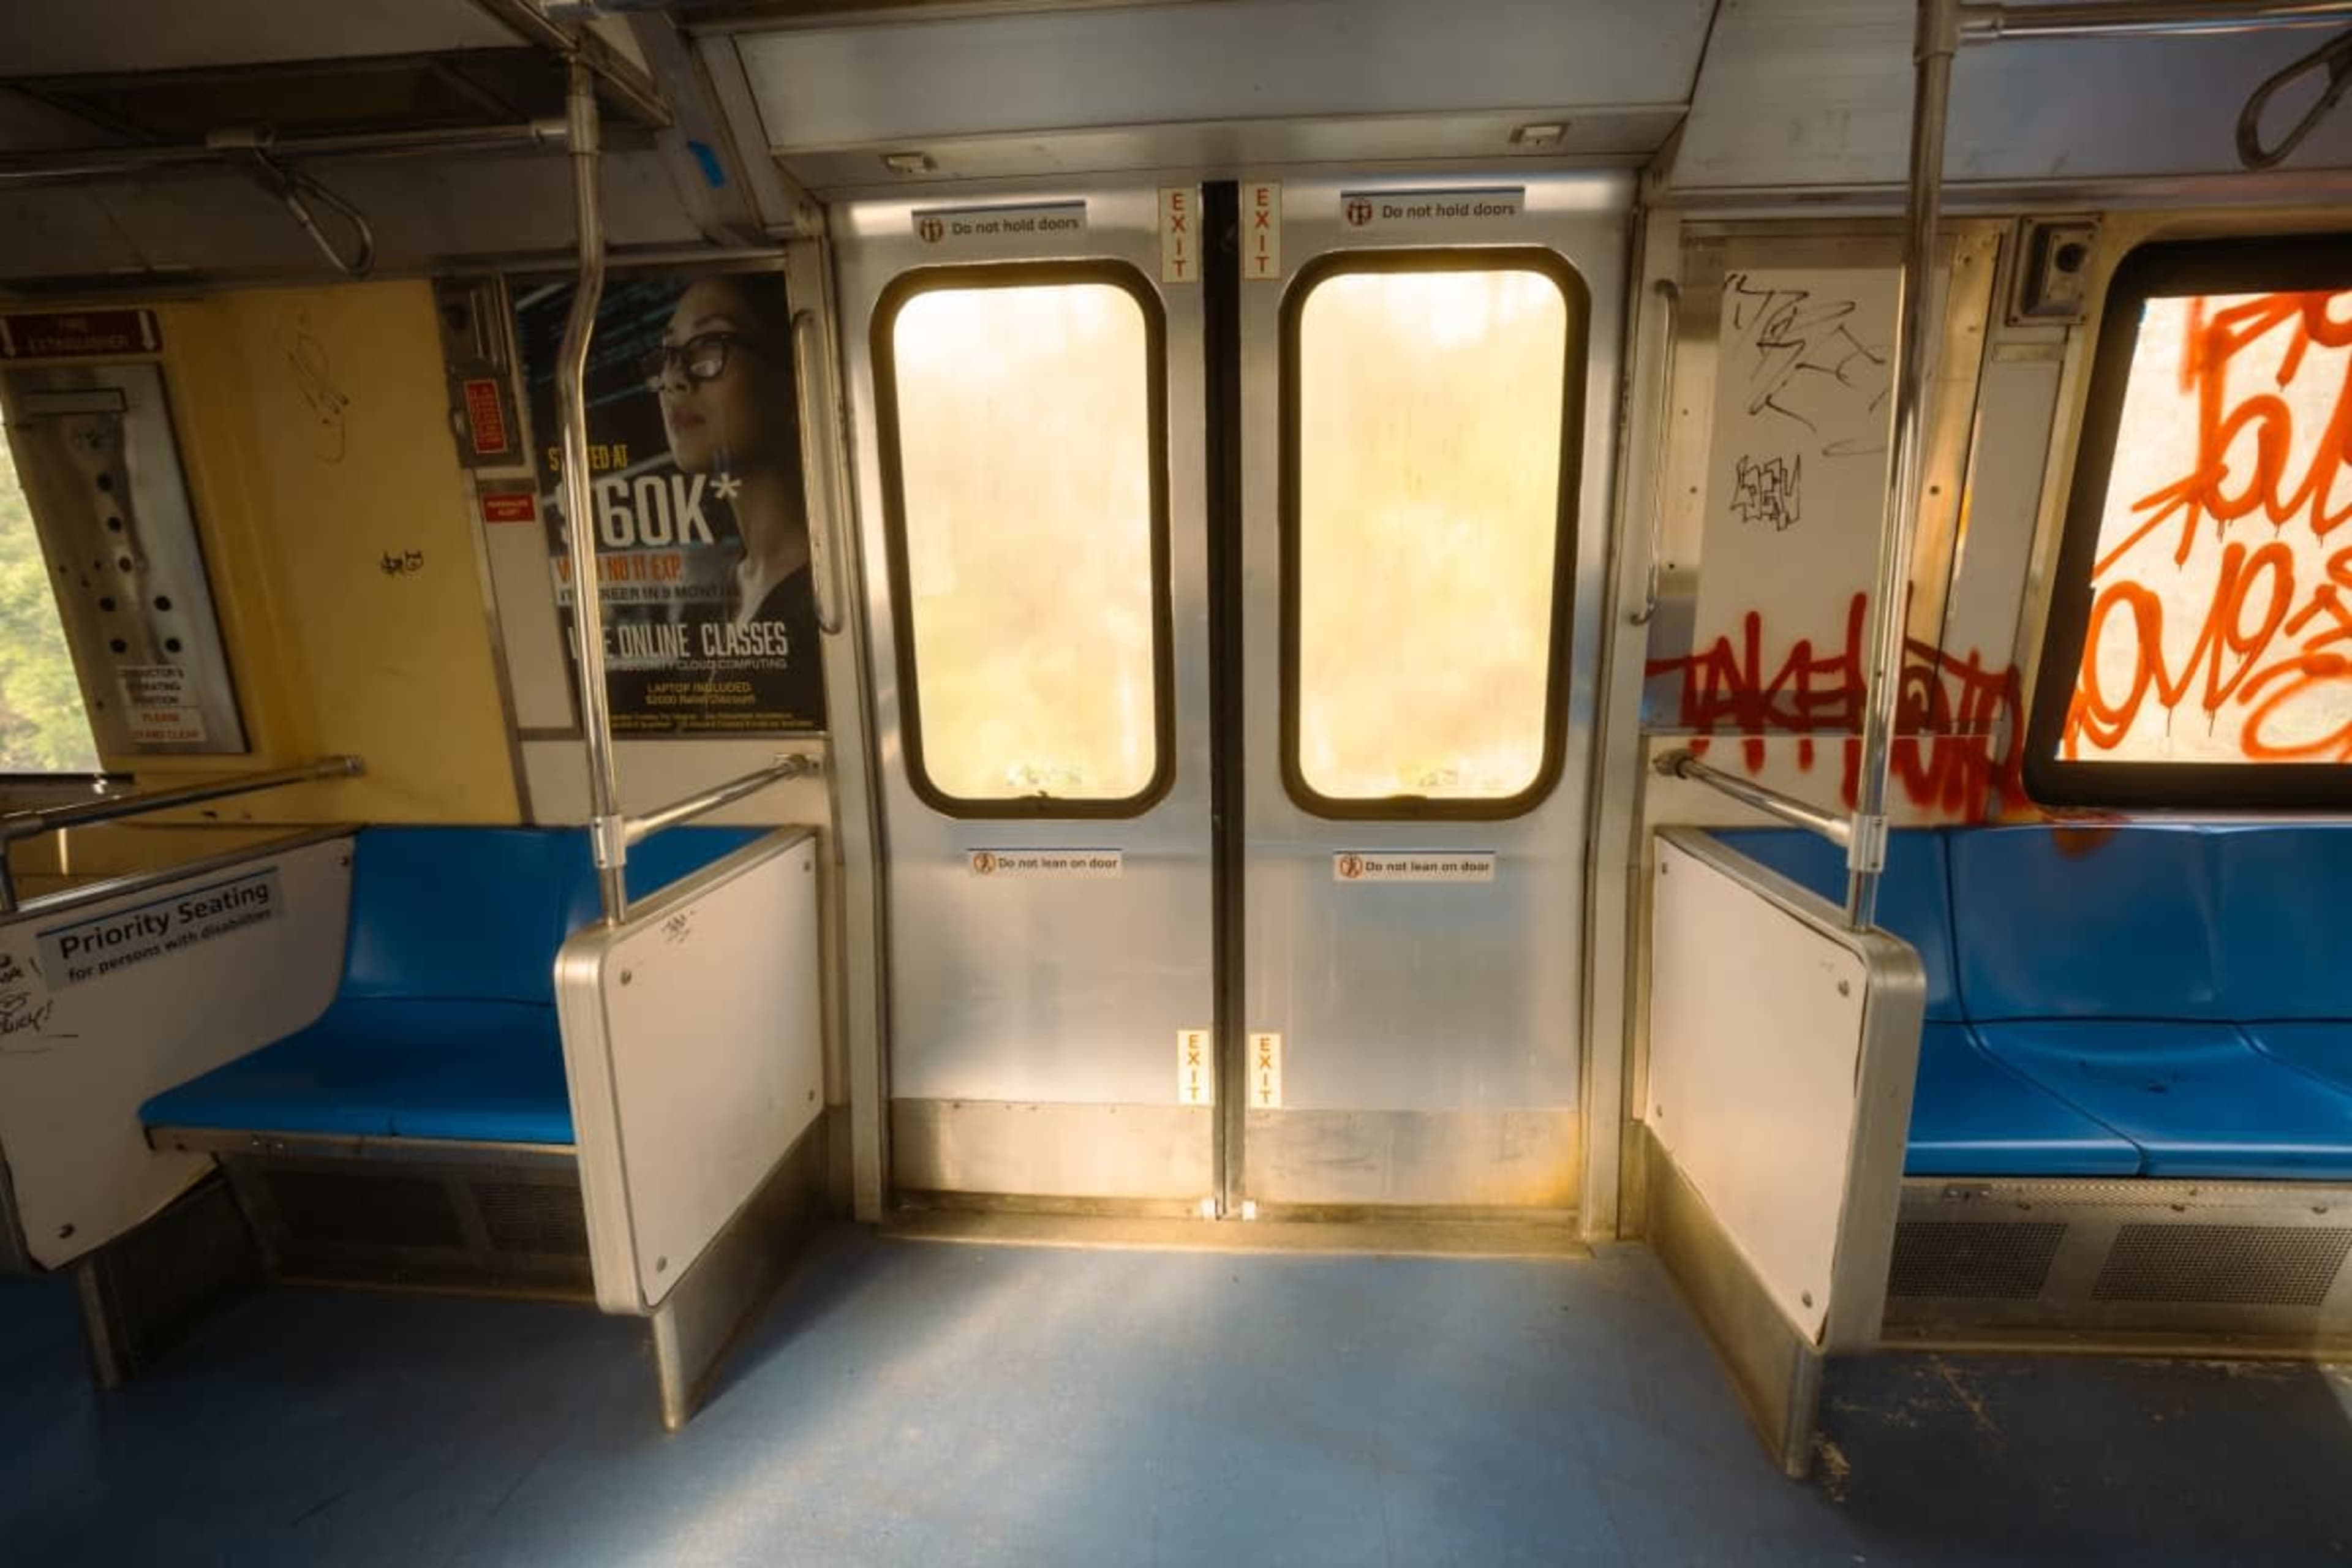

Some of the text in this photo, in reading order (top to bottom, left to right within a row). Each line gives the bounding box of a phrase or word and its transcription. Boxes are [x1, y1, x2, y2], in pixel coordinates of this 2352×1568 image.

[1383, 202, 1515, 218] Do not hold doors
[952, 217, 1079, 235] Do not hold doors
[1172, 193, 1186, 277] EXIT
[1254, 188, 1270, 273] EXIT
[612, 444, 628, 469] AT
[608, 556, 630, 581] NO
[633, 554, 646, 580] IT
[618, 623, 692, 660] ONLINE
[701, 620, 789, 657] CLASSES
[677, 658, 715, 671] CLOUD
[719, 658, 788, 669] COMPUTING
[647, 682, 691, 693] LAPTOP
[998, 858, 1118, 869] Do not lean on door
[1365, 861, 1490, 871] Do not lean on door
[59, 882, 270, 960] Priority Seating
[67, 908, 273, 983] for persons with disabilities
[1187, 1034, 1201, 1101] EXIT
[1259, 1036, 1272, 1104] EXIT
